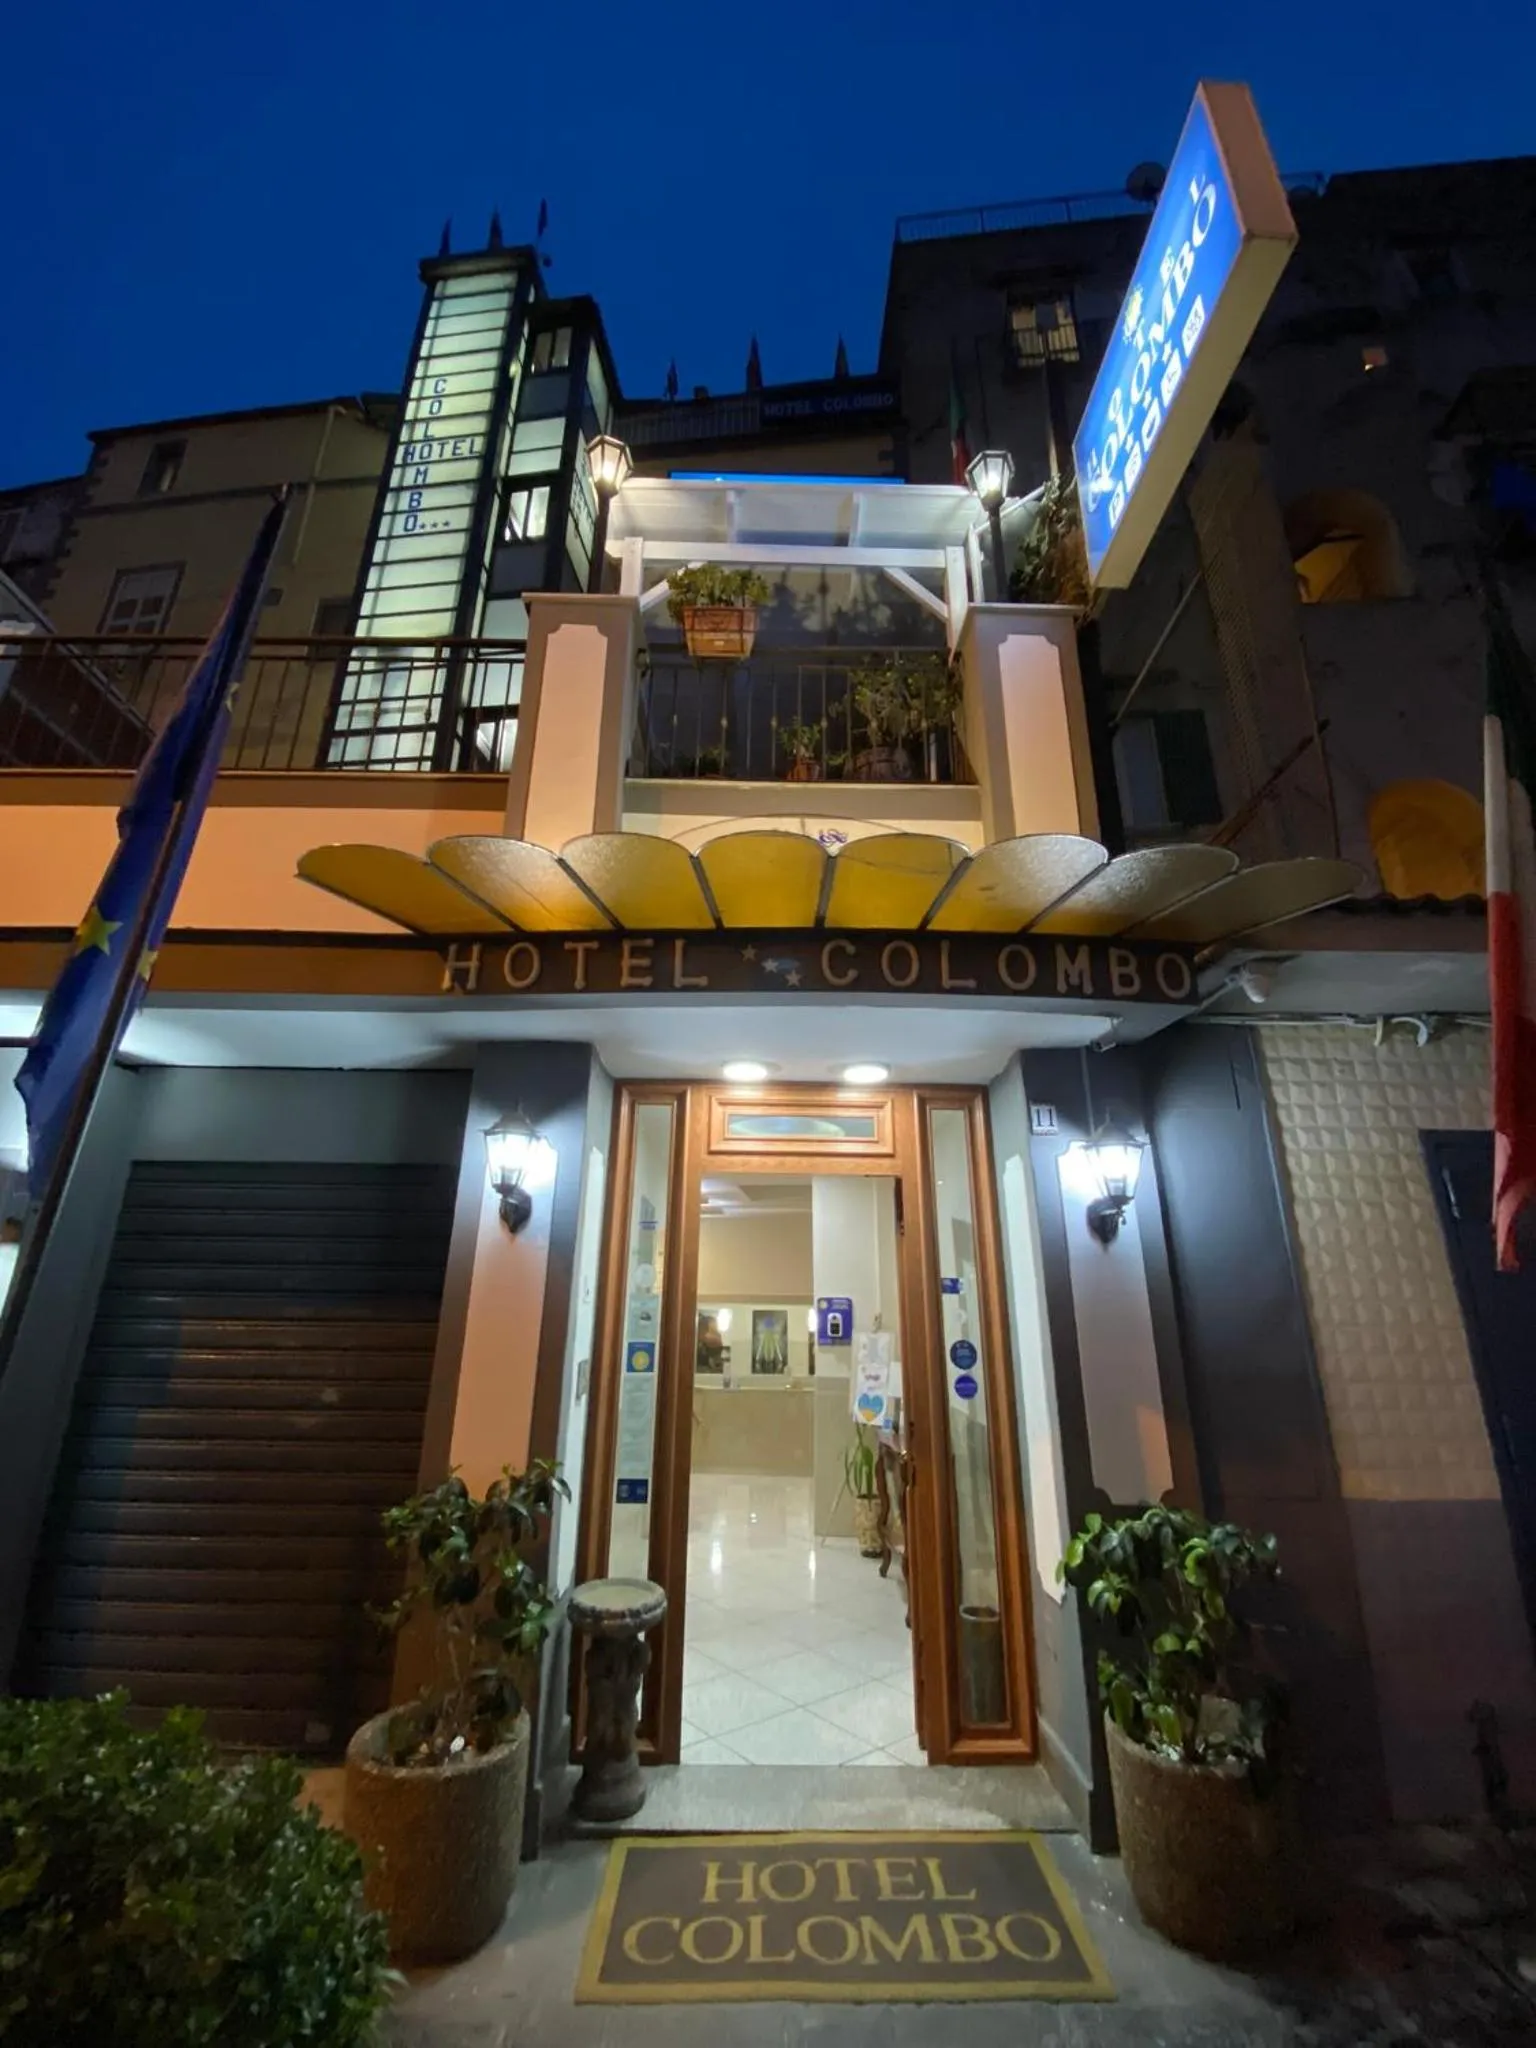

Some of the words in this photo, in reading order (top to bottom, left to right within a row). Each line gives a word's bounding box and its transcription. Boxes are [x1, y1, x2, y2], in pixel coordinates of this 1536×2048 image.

[402, 438, 481, 462] HOTEL
[441, 940, 708, 990] HOTEL
[822, 940, 1192, 998] COLOMBO
[1035, 1108, 1055, 1127] 11
[700, 1857, 977, 1904] HOTEL
[622, 1914, 1063, 1966] COLOMBO
